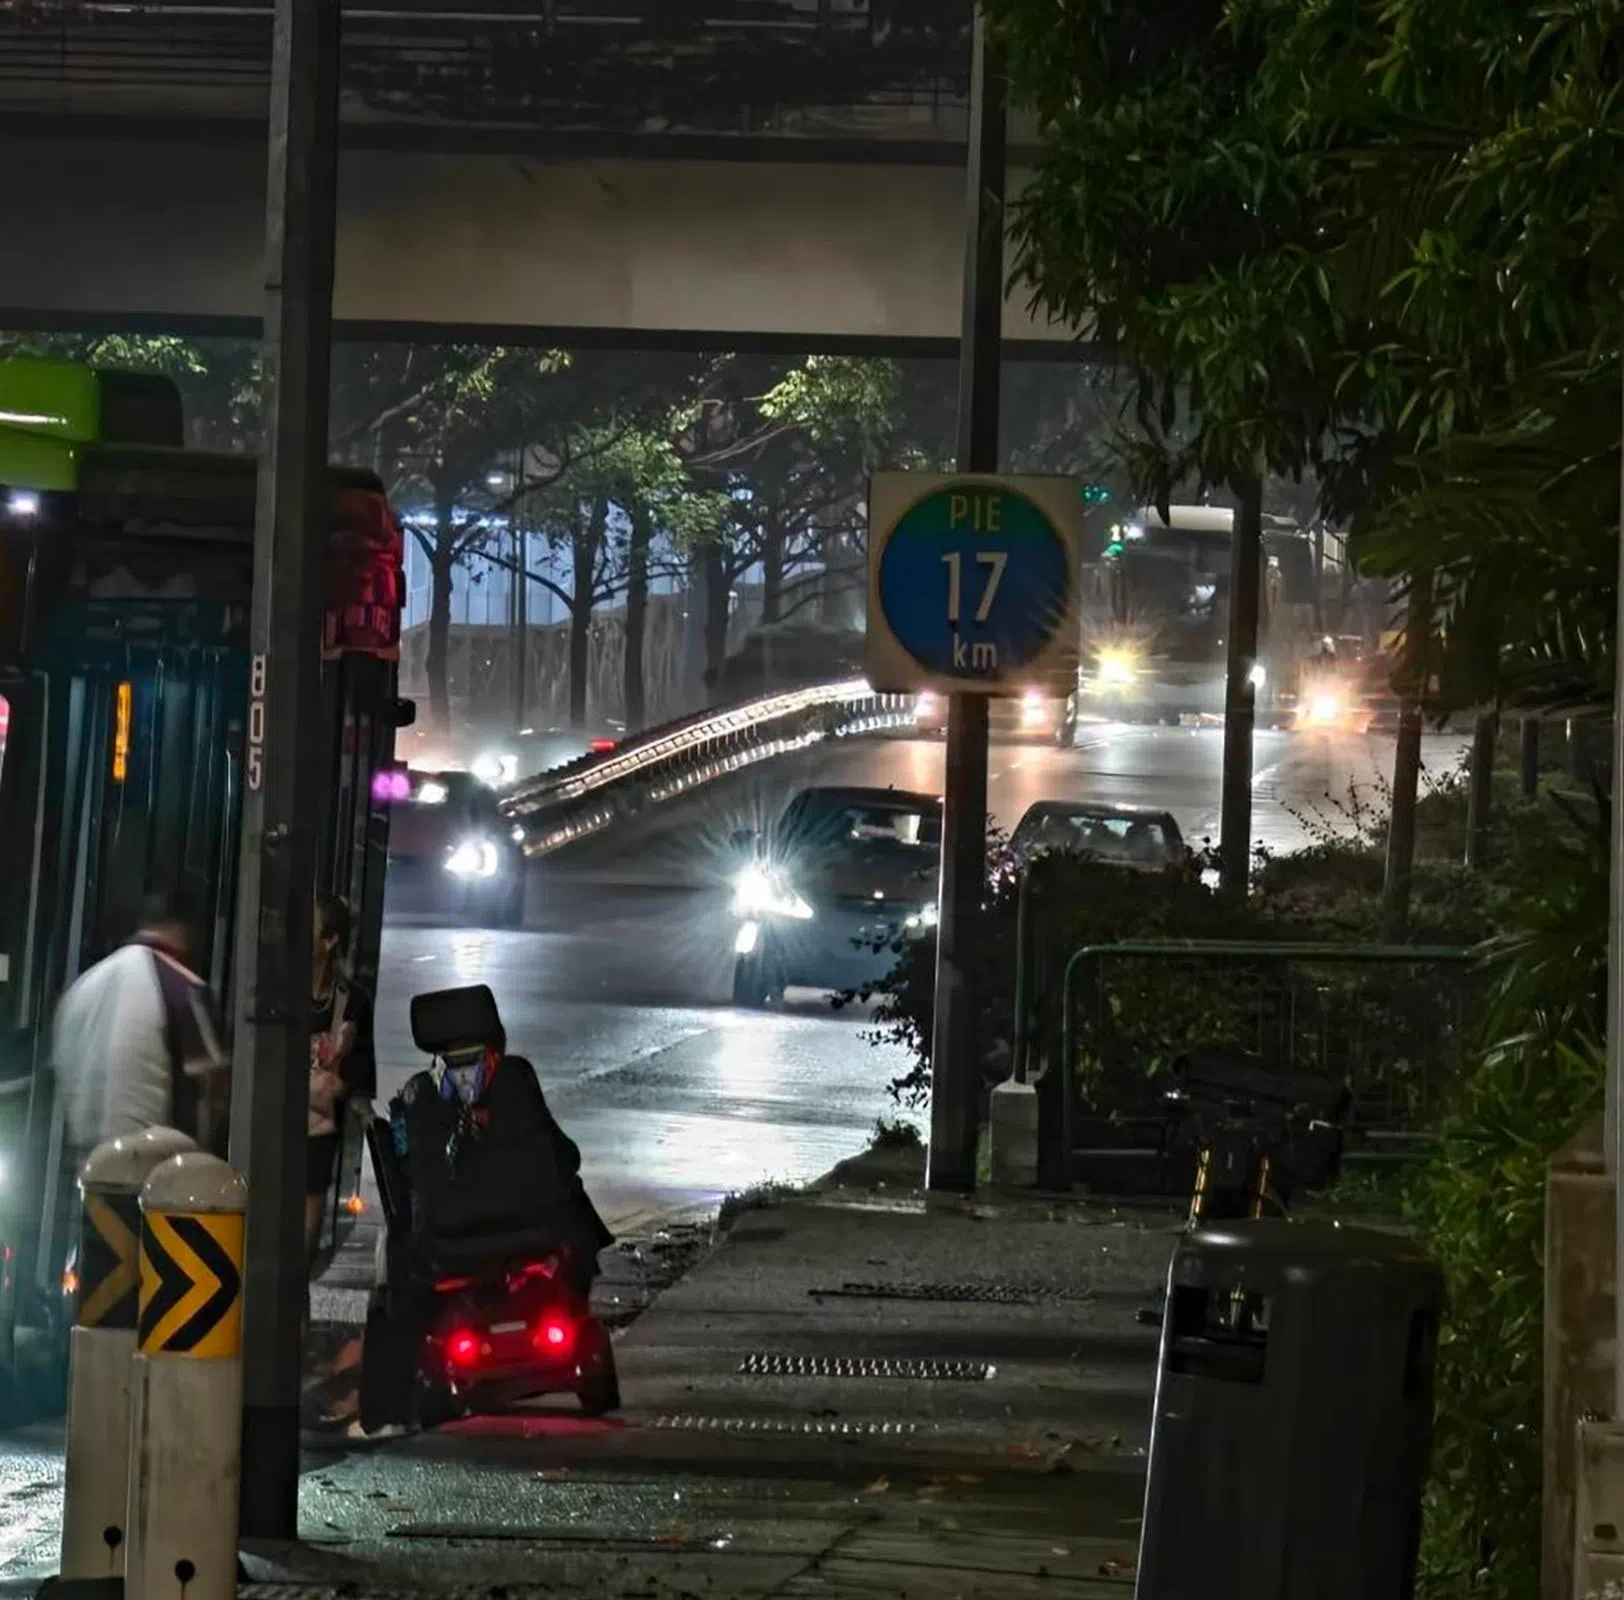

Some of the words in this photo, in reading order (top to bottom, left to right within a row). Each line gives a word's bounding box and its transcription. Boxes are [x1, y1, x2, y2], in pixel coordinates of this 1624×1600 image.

[950, 495, 1002, 532] PIE
[940, 551, 1009, 622] 17
[952, 633, 998, 669] km
[248, 653, 267, 790] 805
